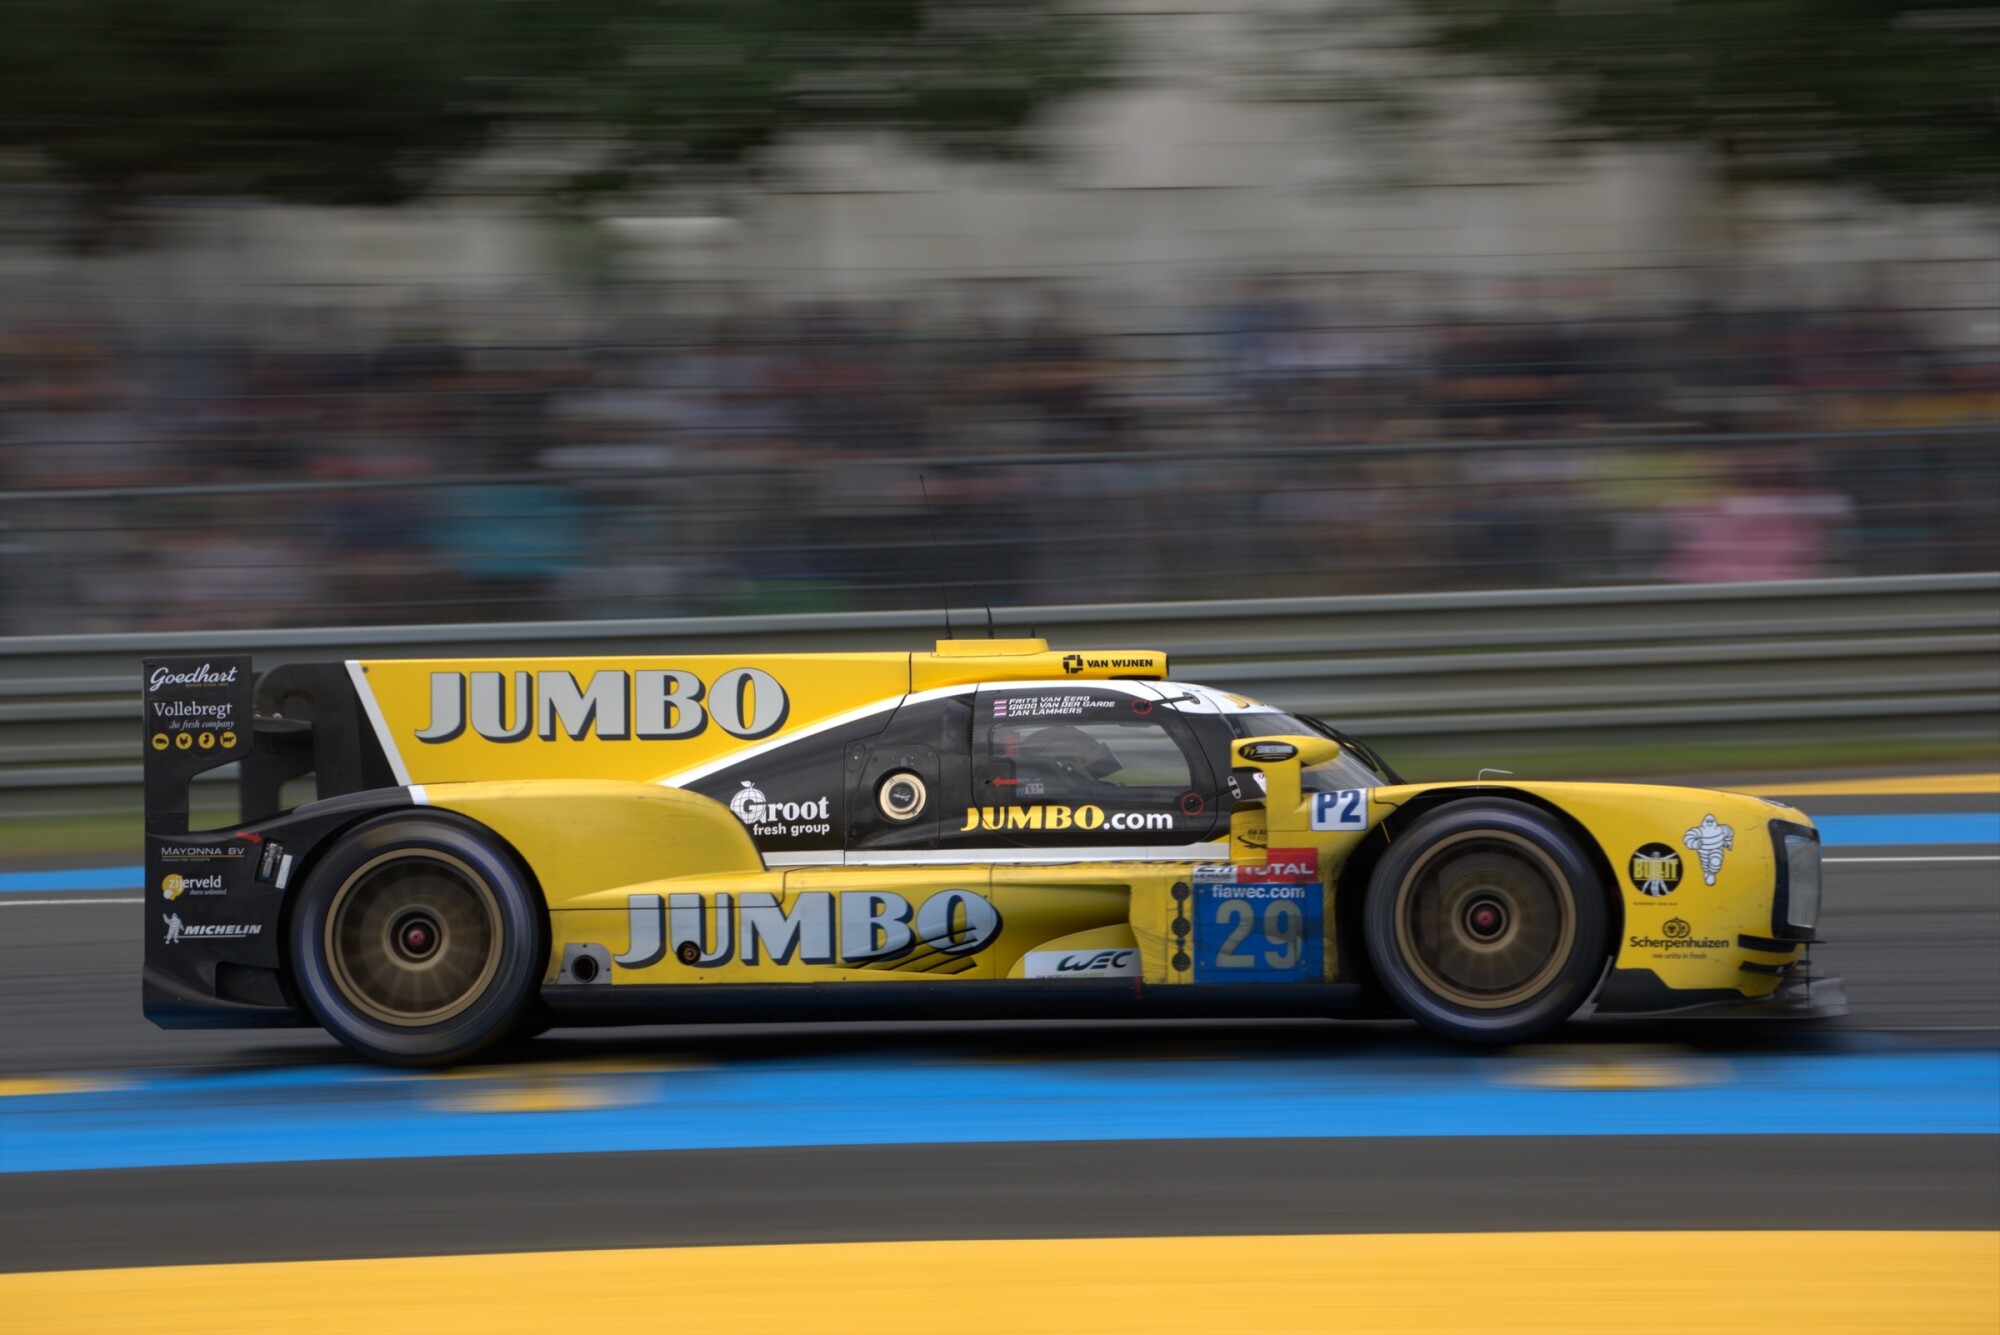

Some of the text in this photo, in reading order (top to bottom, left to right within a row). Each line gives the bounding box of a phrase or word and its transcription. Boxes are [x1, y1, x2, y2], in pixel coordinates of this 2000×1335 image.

[1087, 658, 1153, 668] VAN WIJNEN
[149, 663, 238, 692] Goedhart
[153, 701, 233, 719] Vollebregt
[414, 666, 791, 744] JUMBO
[1008, 707, 1083, 717] JAN LAMMERS
[180, 719, 200, 731] fresh
[201, 720, 235, 731] company
[729, 787, 830, 823] Groot
[1316, 789, 1362, 824] P2
[960, 804, 1173, 832] JUMBO.com
[753, 823, 830, 837] fresh group
[161, 847, 245, 856] MAYONNA BV
[1244, 863, 1315, 875] TOTAL
[1211, 884, 1306, 899] fiawec.com
[184, 924, 262, 935] MICHELIN
[613, 889, 1004, 970] JUMBO
[1215, 899, 1303, 970] 29
[1630, 936, 1730, 951] Scherpenhuizen
[1056, 951, 1134, 972] WEC
